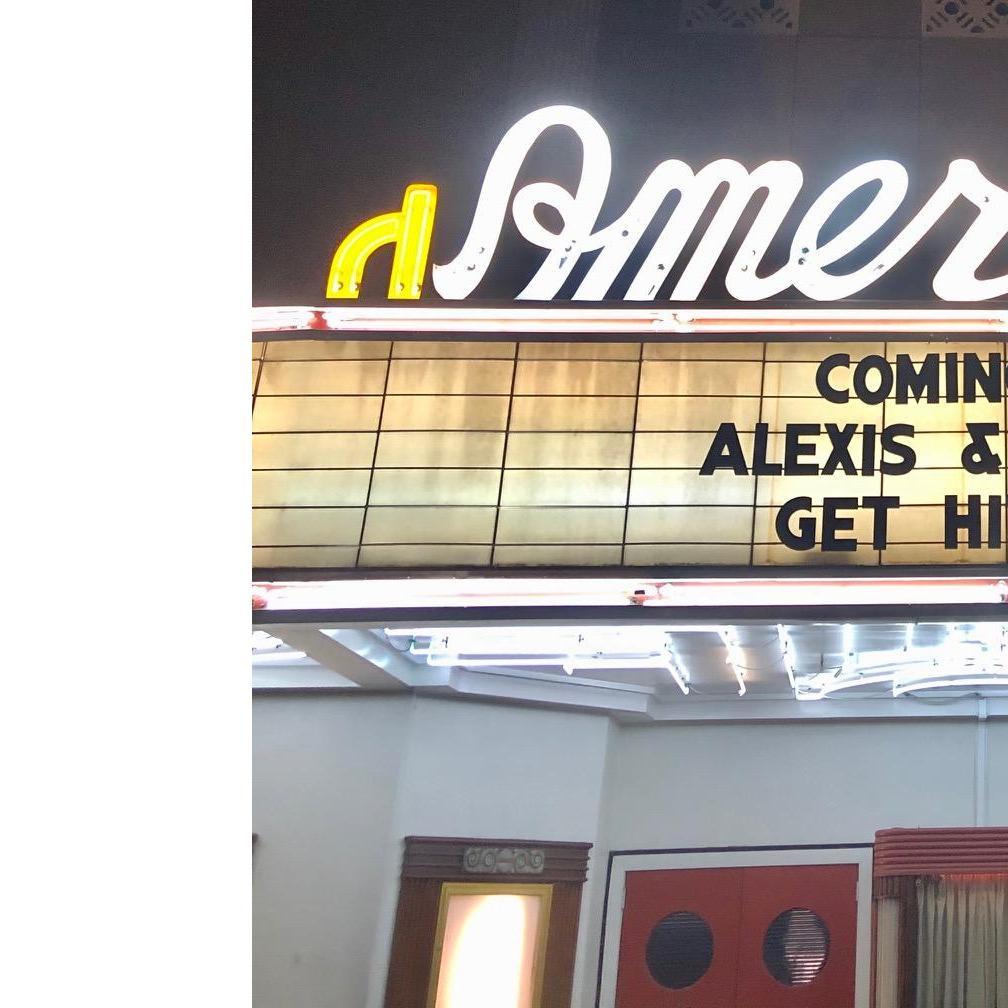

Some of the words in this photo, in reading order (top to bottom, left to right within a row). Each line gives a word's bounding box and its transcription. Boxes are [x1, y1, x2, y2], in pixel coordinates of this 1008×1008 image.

[700, 423, 917, 477] ALEXIS
[962, 423, 1001, 476] &
[775, 496, 901, 552] GET
